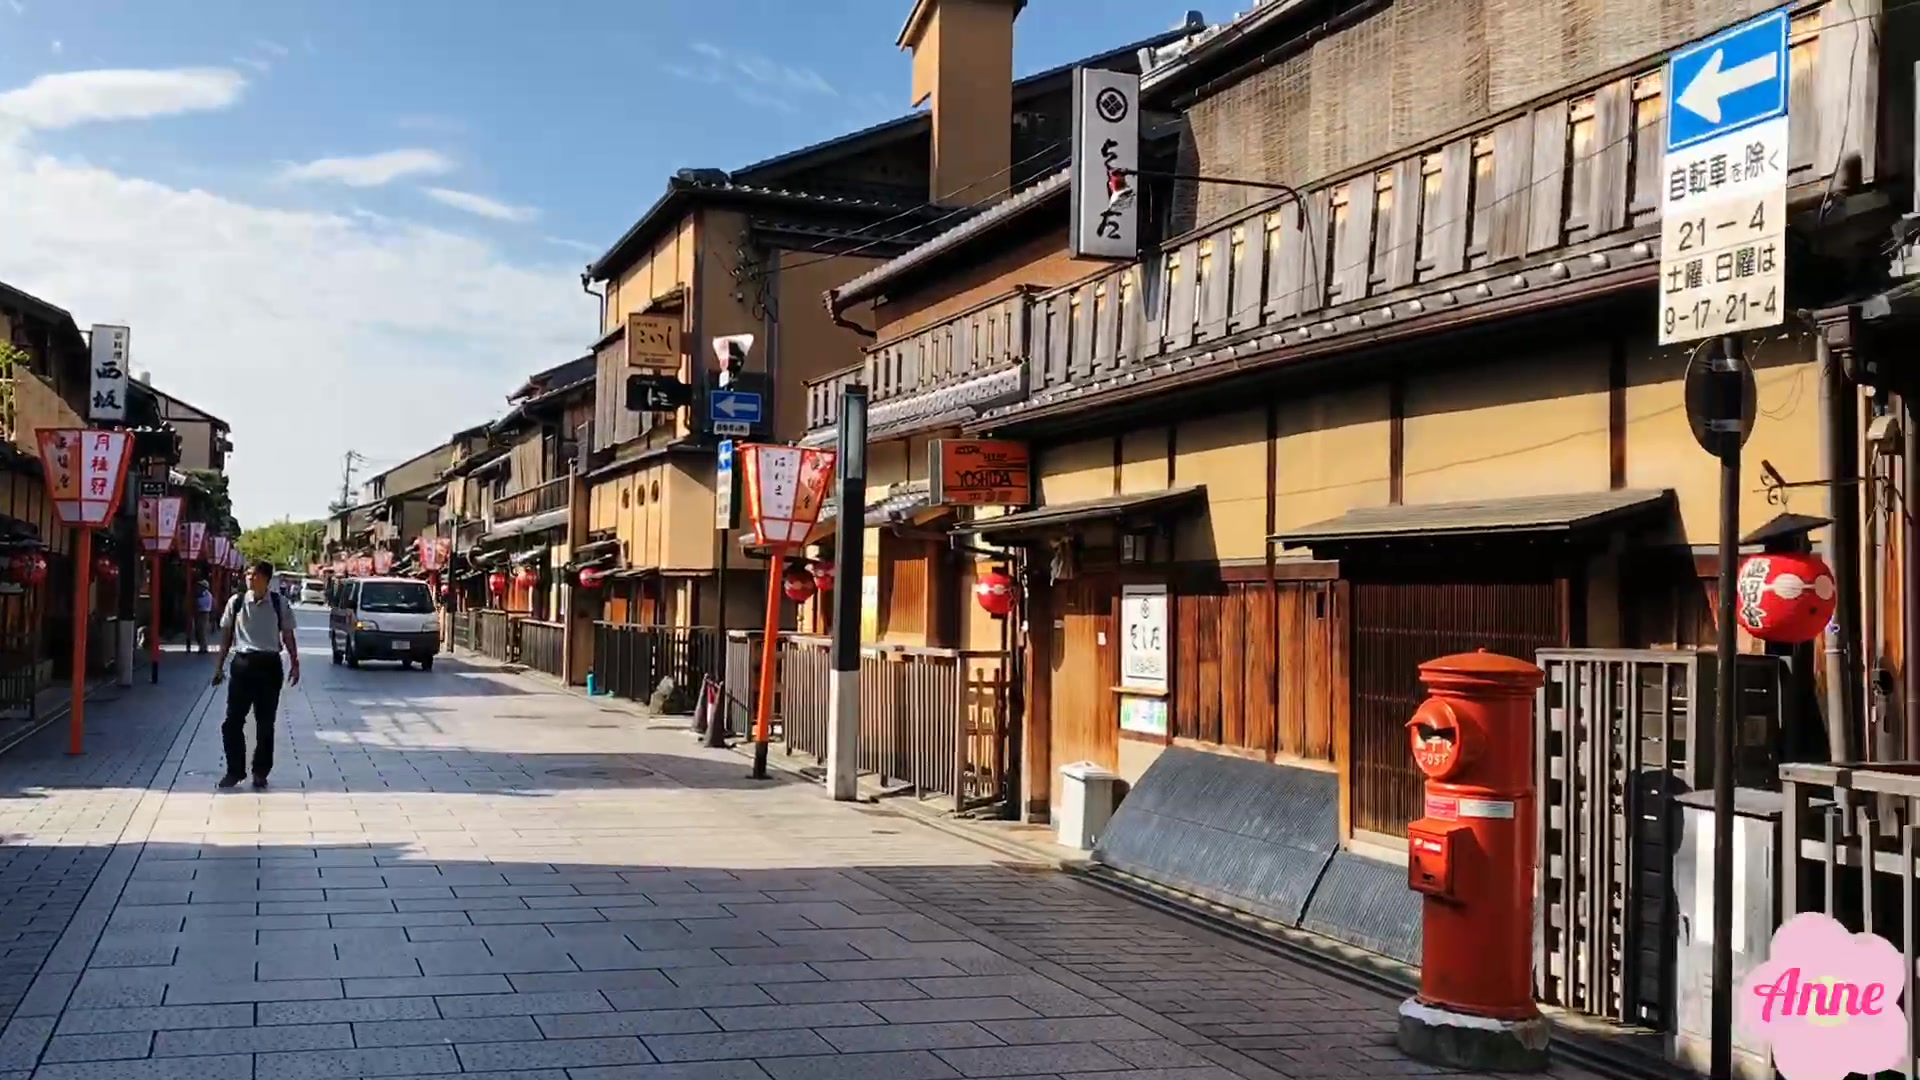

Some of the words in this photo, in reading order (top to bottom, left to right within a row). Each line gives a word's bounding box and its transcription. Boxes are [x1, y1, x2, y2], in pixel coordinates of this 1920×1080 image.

[1669, 141, 1780, 201] 自転車を除く
[1665, 246, 1777, 293] 土曜、日曜は
[91, 434, 111, 496] 月桂冠
[956, 470, 1012, 488] YOSHIDA
[1421, 752, 1448, 766] POST
